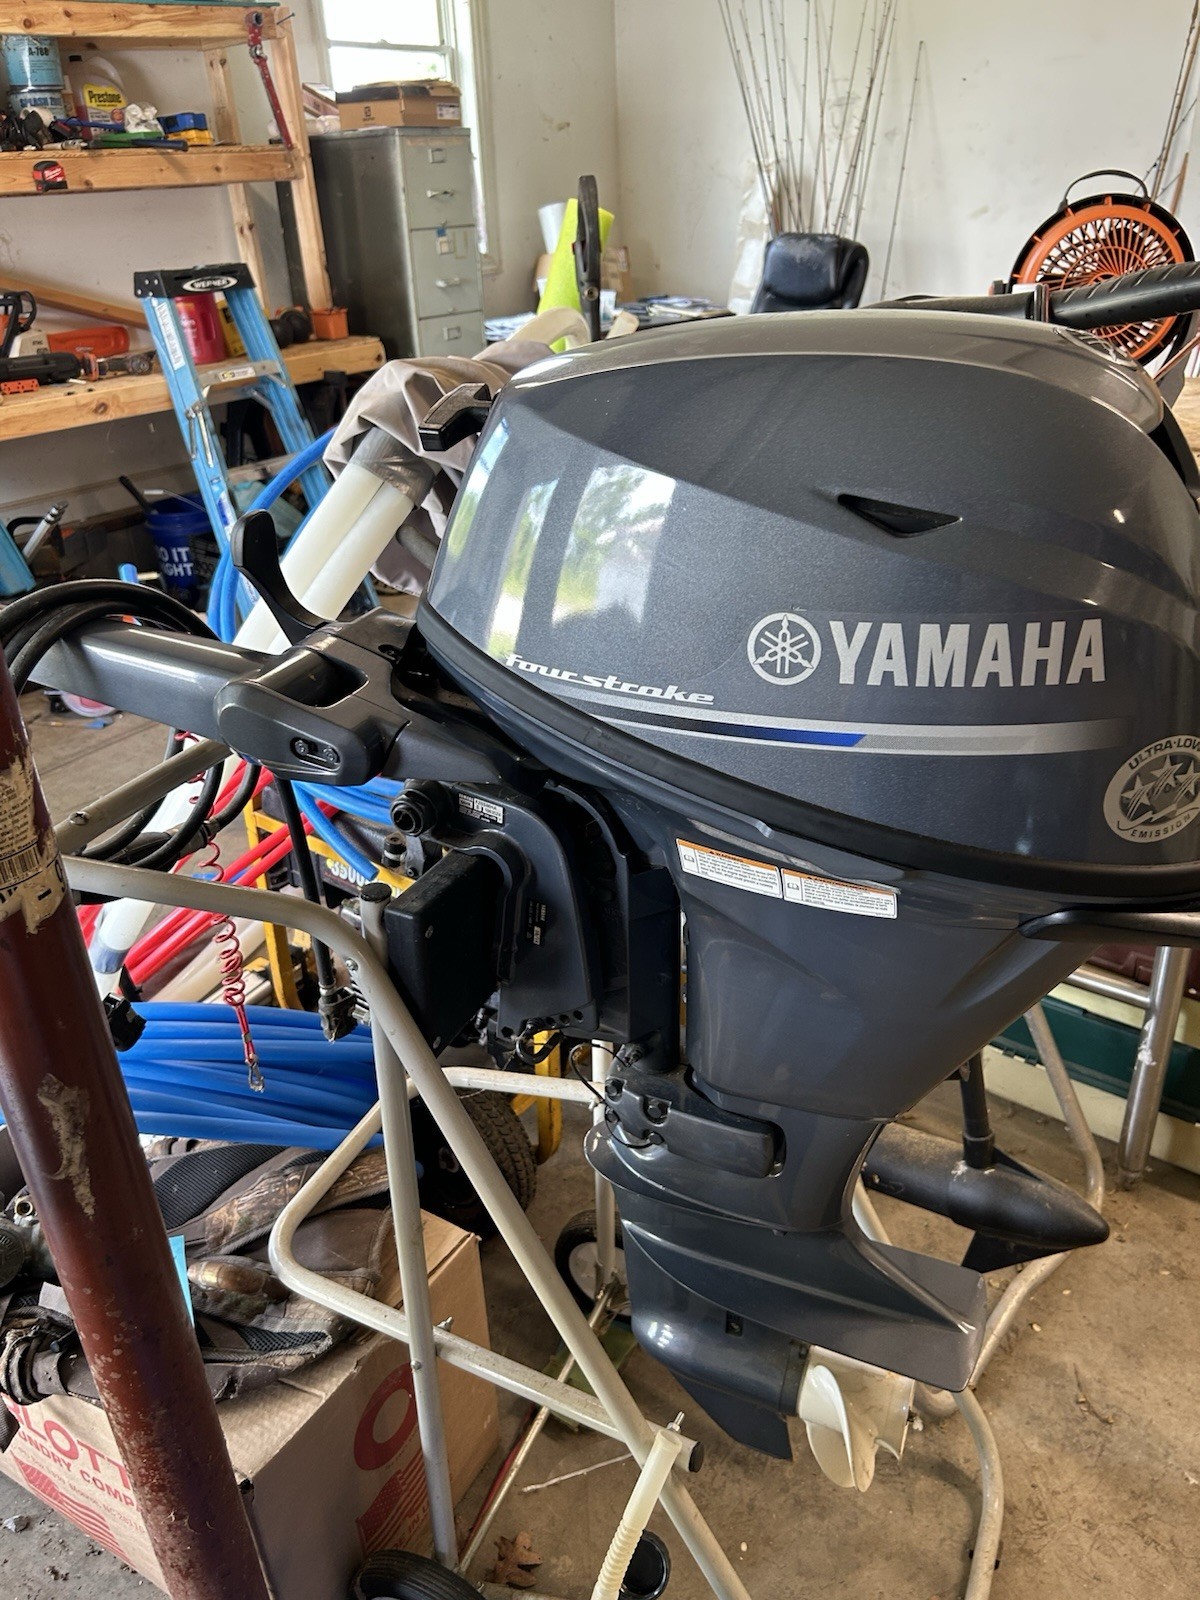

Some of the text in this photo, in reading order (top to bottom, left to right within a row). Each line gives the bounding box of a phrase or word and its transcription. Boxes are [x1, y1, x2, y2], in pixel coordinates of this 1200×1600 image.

[88, 90, 122, 104] Prestone
[192, 279, 228, 289] WERNER
[171, 546, 190, 563] IT
[828, 618, 1106, 688] YAMAHA
[1130, 813, 1191, 839] EMISSION
